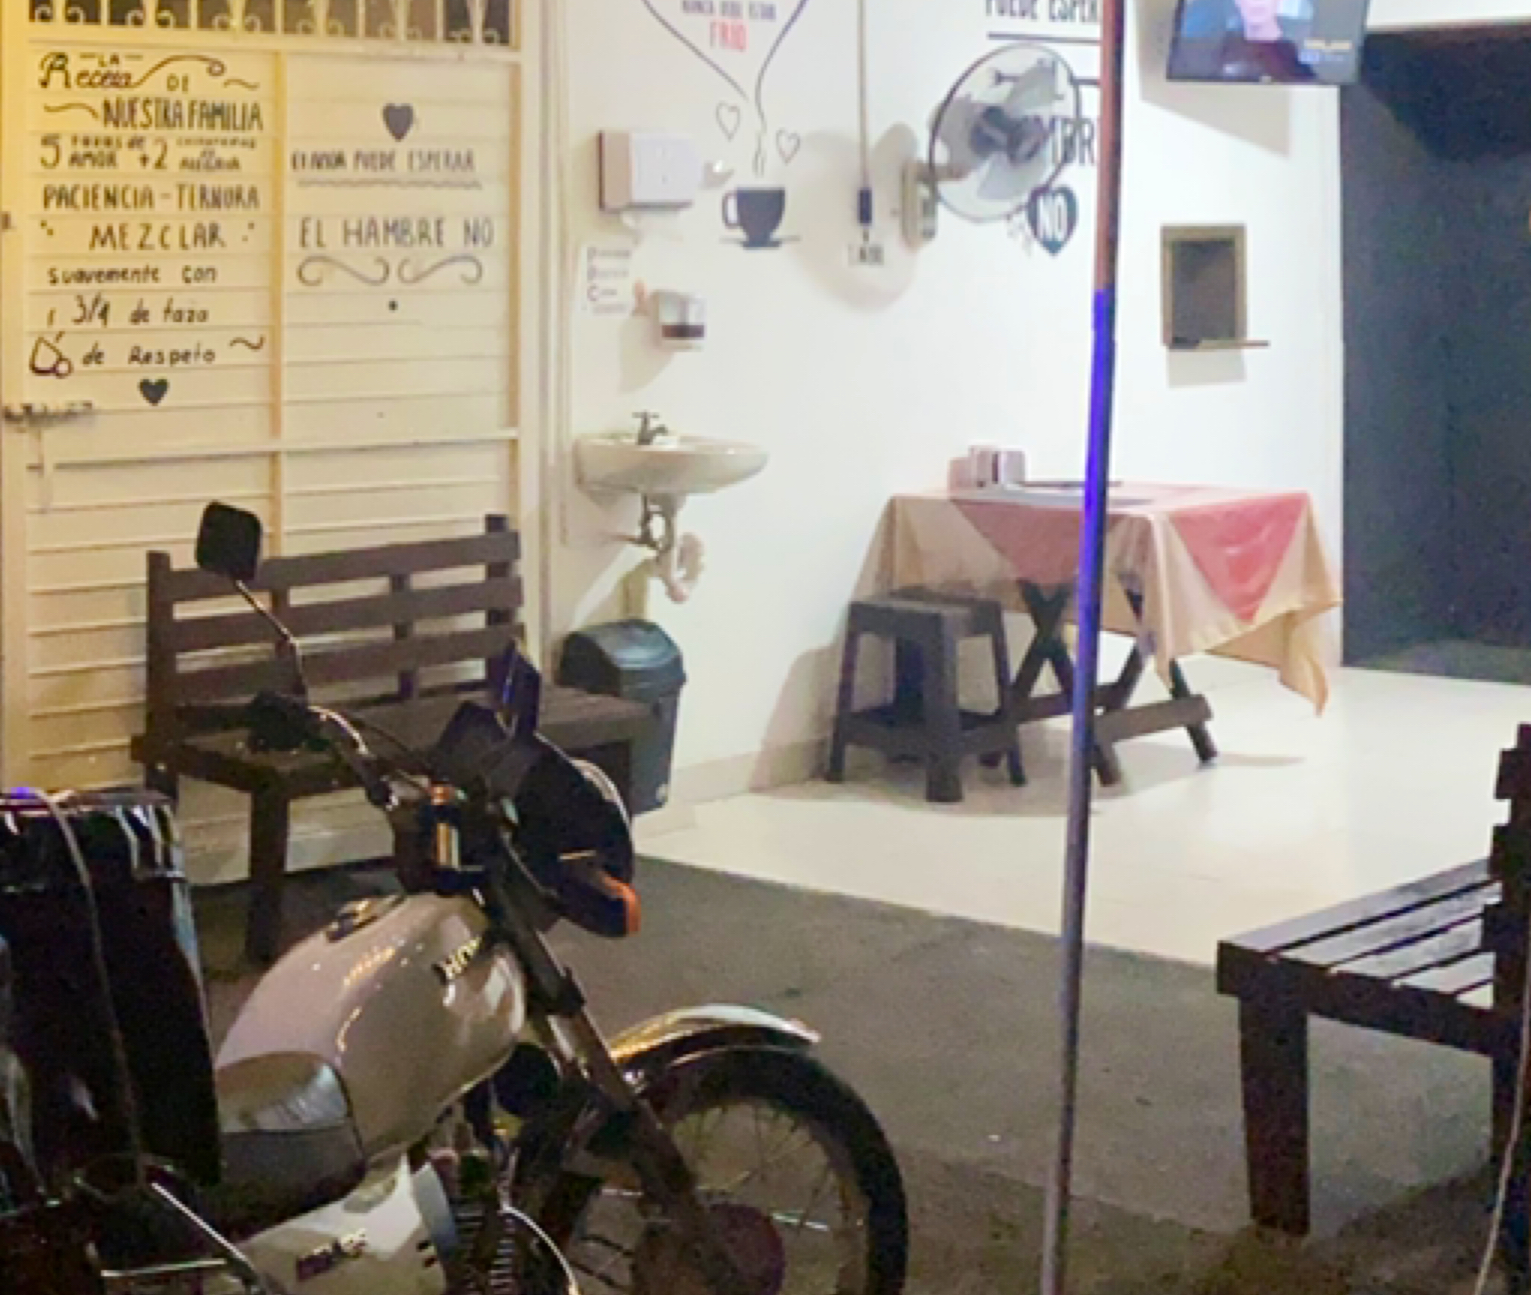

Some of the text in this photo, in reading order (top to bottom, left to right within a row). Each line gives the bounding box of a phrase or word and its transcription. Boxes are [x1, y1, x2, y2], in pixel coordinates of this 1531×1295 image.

[103, 96, 264, 131] NUESTRA FAMILIA
[39, 133, 61, 170] 5
[43, 183, 155, 211] PACIENCIA
[176, 183, 261, 211] TERNURA
[299, 217, 495, 248] EL HAMBRE NO
[1038, 195, 1068, 241] NO
[88, 222, 227, 251] MEZCLAR
[82, 340, 217, 366] de Respeto
